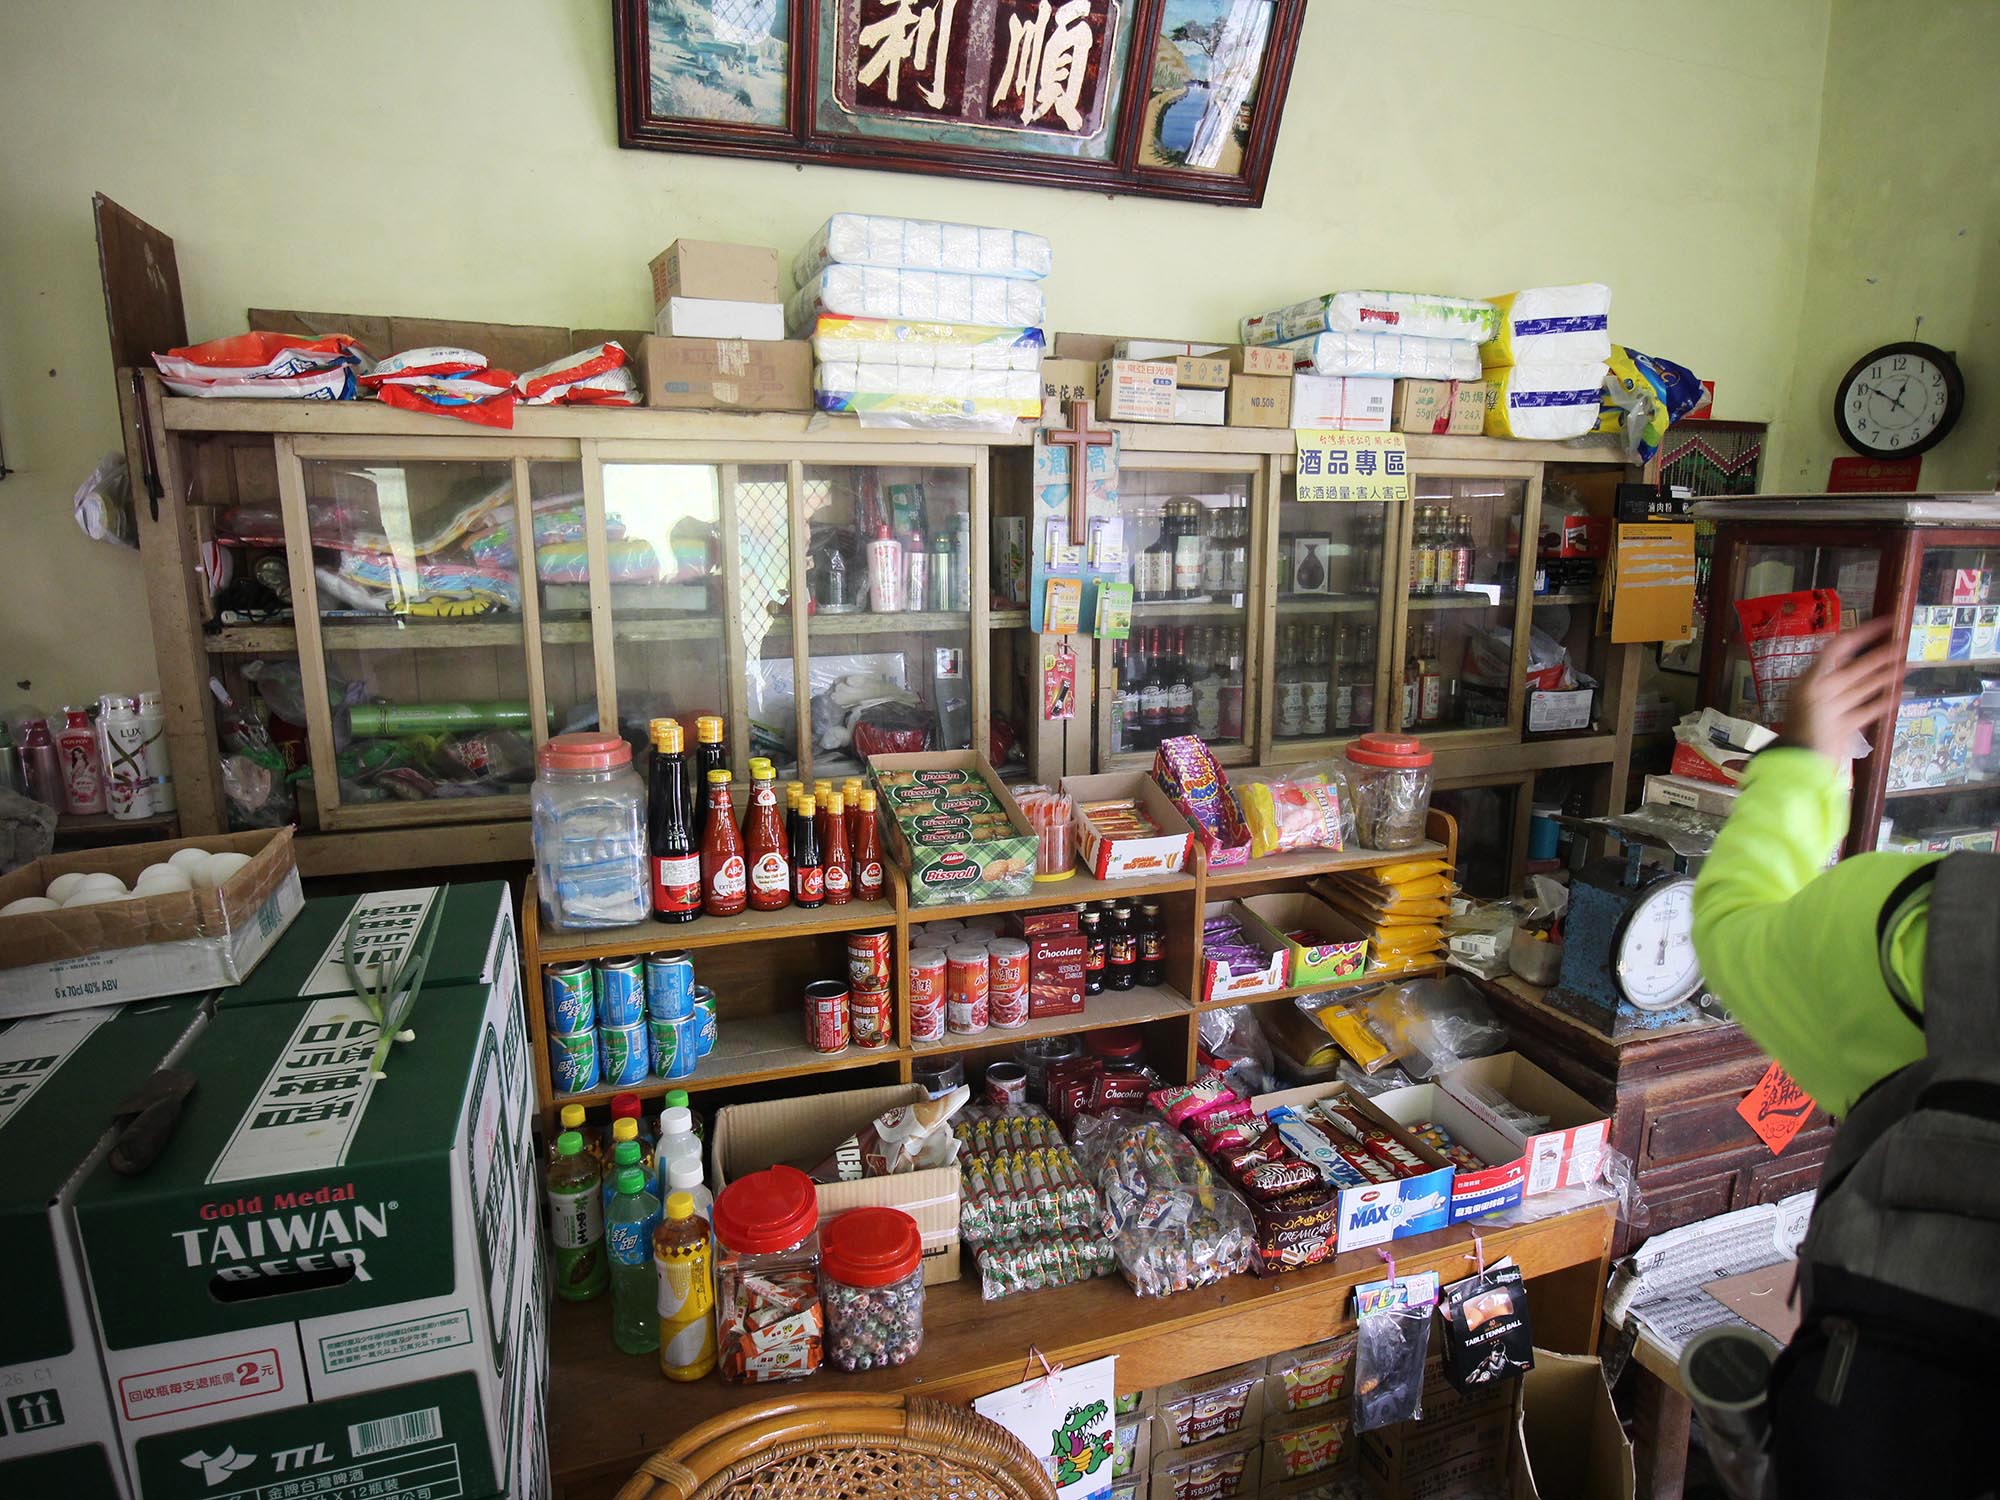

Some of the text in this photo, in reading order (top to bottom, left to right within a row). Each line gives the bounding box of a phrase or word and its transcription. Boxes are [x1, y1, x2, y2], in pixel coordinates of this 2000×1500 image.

[1892, 357, 1907, 371] 12
[1920, 361, 1925, 373] 1
[1871, 366, 1882, 379] 11
[1932, 375, 1942, 387] 2
[1857, 383, 1869, 396] 10
[1935, 392, 1945, 406] 3
[1853, 400, 1862, 413] 9
[1858, 418, 1866, 430] 8
[1928, 413, 1937, 425] 4
[1871, 431, 1880, 443] 7
[1890, 434, 1899, 447] 6
[1911, 428, 1920, 441] 5
[1298, 448, 1406, 476] 酒品專區
[120, 727, 142, 738] LUX
[727, 865, 743, 875] ABC
[925, 866, 978, 882] Bissroll
[1037, 947, 1083, 960] Chocolate
[54, 979, 118, 999] 6 x 70cl 40% ABV
[250, 1020, 377, 1130] 台灣啤酒
[1105, 1088, 1145, 1100] Chocolate
[200, 1183, 355, 1220] Gold Medal
[1349, 1205, 1390, 1231] MAX
[172, 1202, 388, 1267] TAIWAN
[1465, 1319, 1523, 1347] TABLE TENNIS BALL
[1193, 1412, 1227, 1431] 巧克力奶茶
[271, 1441, 335, 1473] TTL
[267, 1468, 365, 1500] 金牌台灣啤酒
